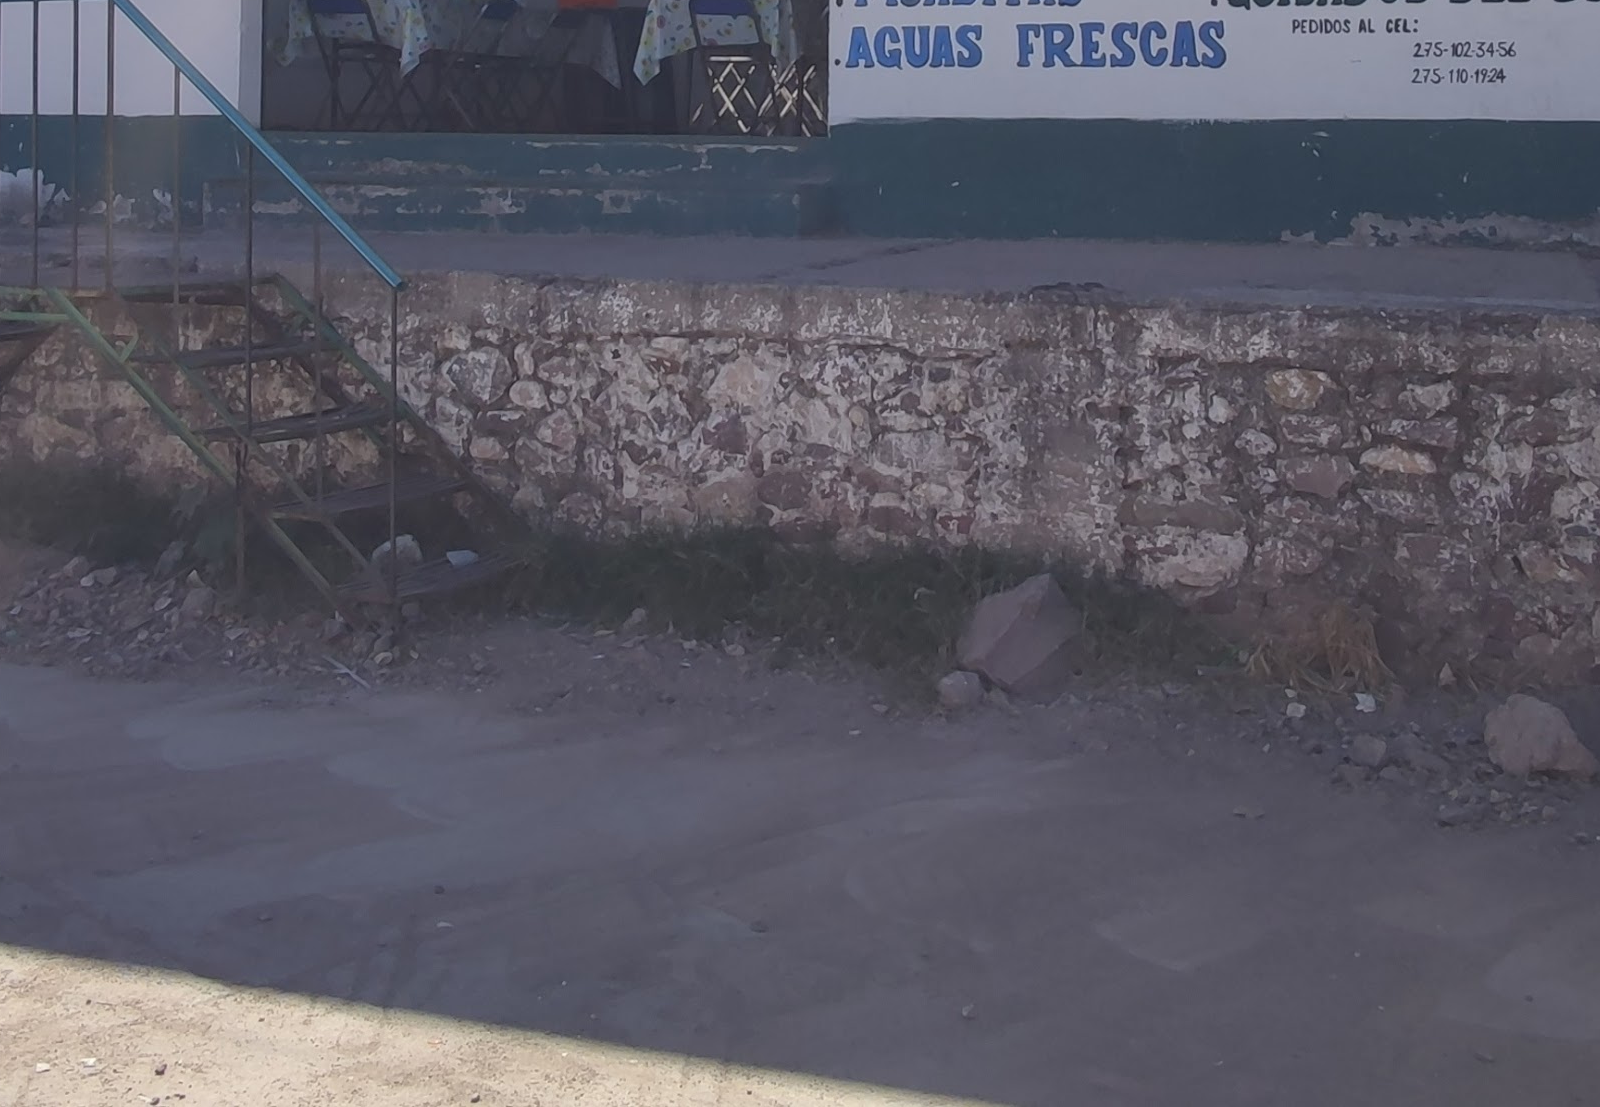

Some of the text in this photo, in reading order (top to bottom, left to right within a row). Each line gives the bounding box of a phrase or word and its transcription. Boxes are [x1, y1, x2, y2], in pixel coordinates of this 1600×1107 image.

[1292, 17, 1419, 34] PEDIDOS AL CEL:
[845, 19, 1227, 70] AGUAS FRESCAS
